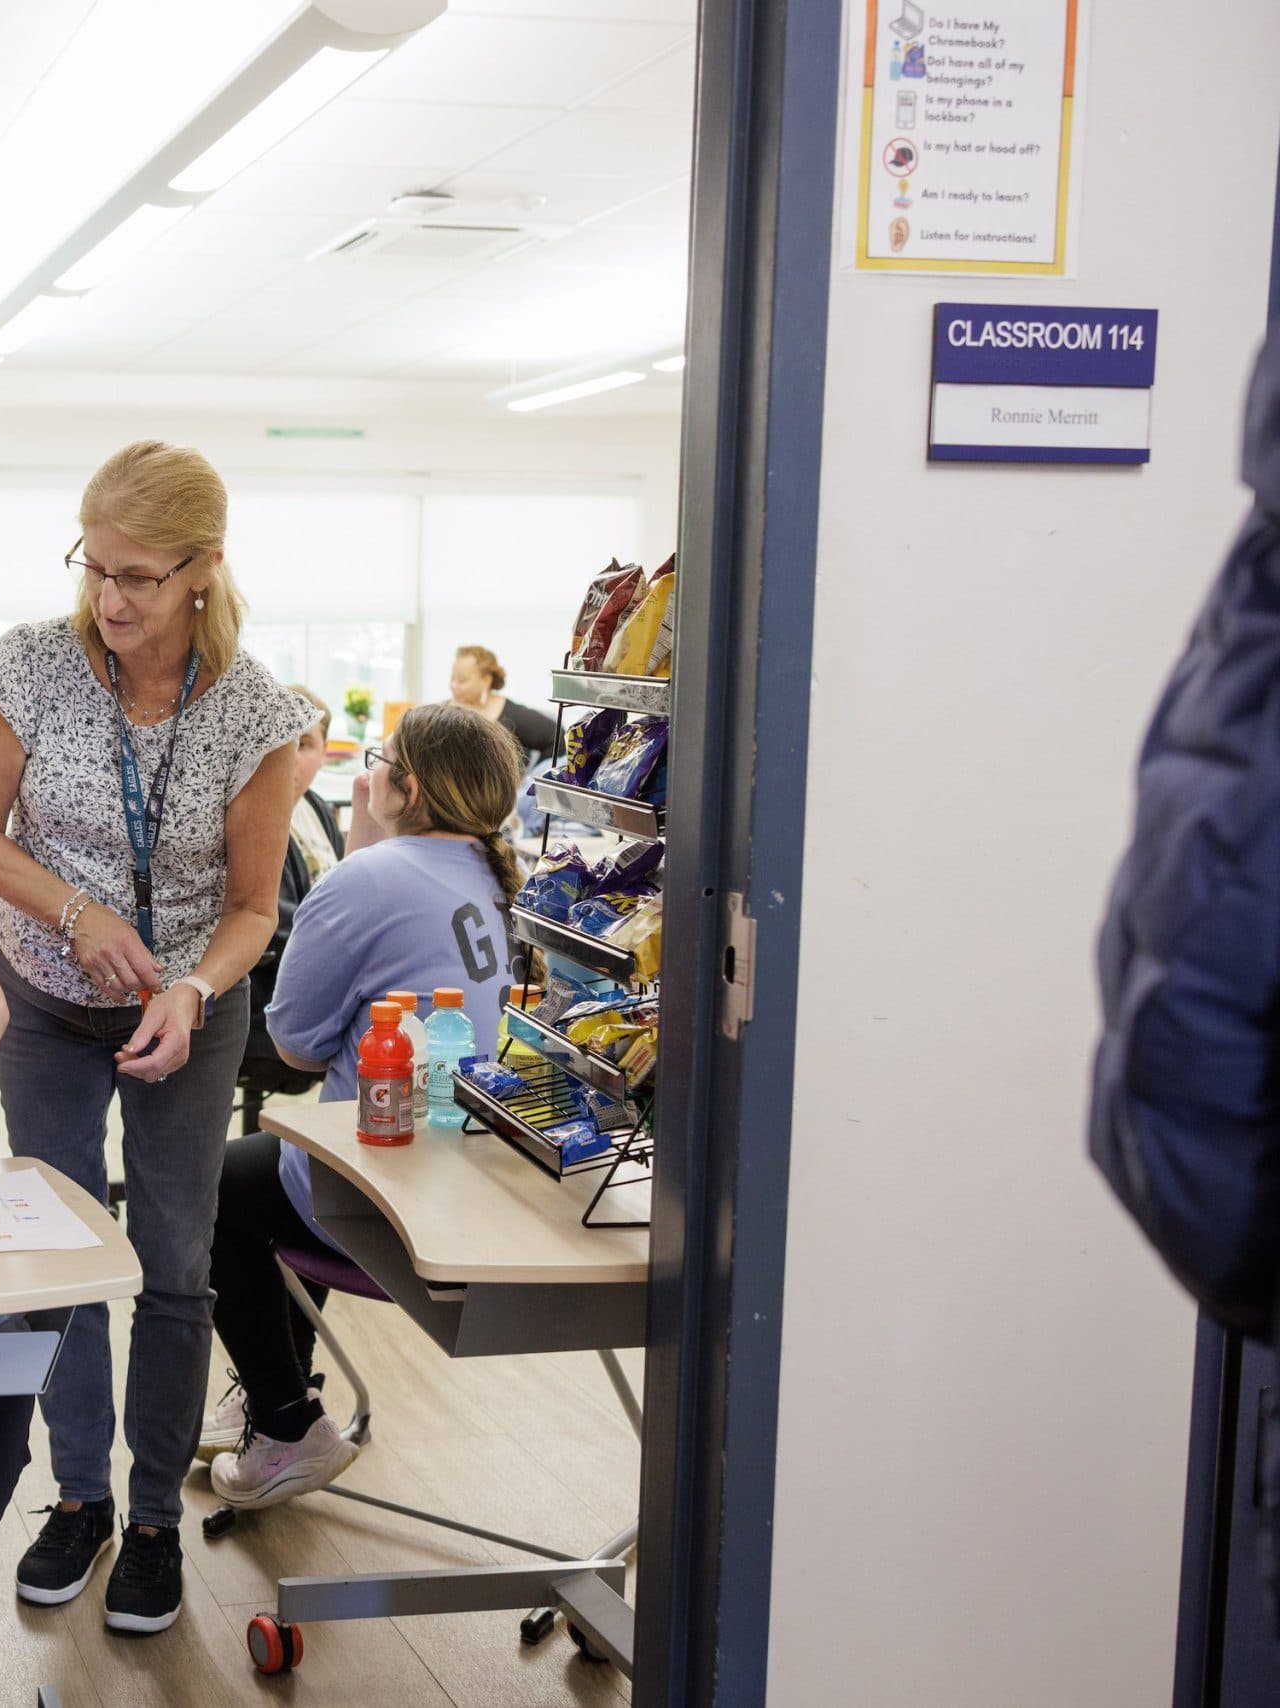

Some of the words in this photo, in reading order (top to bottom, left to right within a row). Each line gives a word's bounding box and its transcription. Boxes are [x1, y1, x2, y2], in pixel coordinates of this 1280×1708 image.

[928, 17, 944, 29] Do
[953, 18, 980, 30] have
[983, 20, 1001, 34] My
[927, 34, 1006, 49] Chromebook?
[948, 56, 975, 68] have
[978, 58, 992, 69] all
[995, 58, 1006, 70] of
[1008, 62, 1025, 74] my
[926, 72, 993, 89] belongings?
[925, 94, 934, 105] Is
[937, 97, 953, 108] my
[956, 94, 990, 108] phone
[992, 96, 1003, 108] in
[1006, 99, 1013, 108] a
[924, 109, 975, 123] lockbox?
[923, 140, 932, 151] Is
[934, 143, 951, 155] my
[953, 139, 972, 153] hat
[975, 144, 986, 153] or
[989, 142, 1017, 155] hood
[1019, 143, 1041, 156] off?
[921, 188, 938, 199] Am
[948, 189, 979, 204] ready
[982, 191, 993, 201] to
[995, 190, 1030, 203] learn?
[920, 229, 952, 241] Listen
[954, 229, 970, 242] for
[972, 231, 1037, 244] instructions!
[948, 320, 1102, 350] CLASSROOM
[1108, 324, 1144, 351] 114
[990, 407, 1043, 425] Ronnie
[1047, 408, 1099, 426] Merritt
[126, 764, 138, 793] EAGLES
[155, 766, 169, 796] EAGLES
[133, 820, 145, 849] EAGLES
[370, 1084, 391, 1108] G
